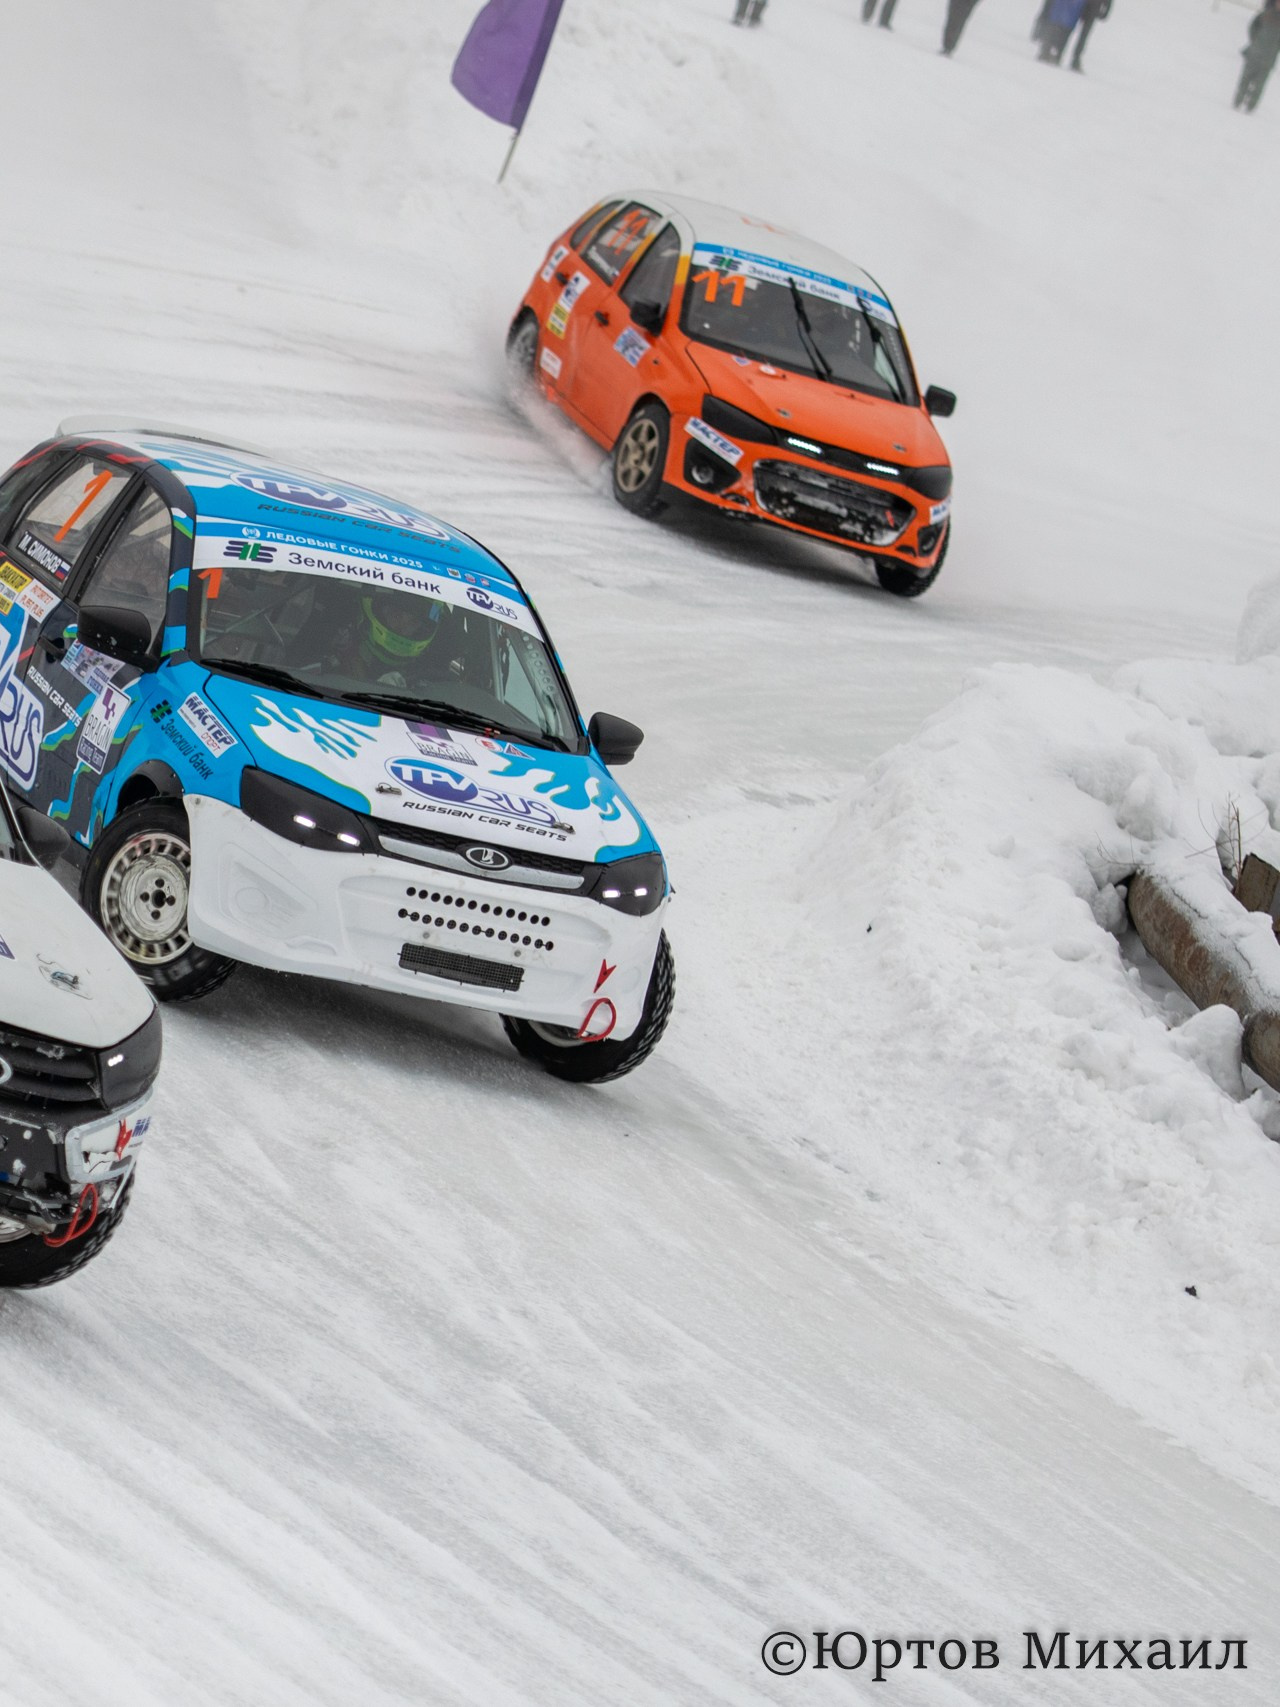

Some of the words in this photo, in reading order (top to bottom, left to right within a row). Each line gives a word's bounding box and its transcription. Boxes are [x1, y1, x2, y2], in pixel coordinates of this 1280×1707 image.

[608, 208, 649, 255] 11
[692, 270, 747, 307] 11
[54, 469, 113, 542] 1
[249, 477, 339, 502] TPV
[266, 530, 338, 550] ЛЕДОВЫЕ
[340, 544, 389, 562] ГОНКИ
[391, 555, 424, 569] 2025
[197, 568, 223, 599] 1
[288, 551, 386, 581] Земский
[391, 571, 442, 595] банк
[468, 590, 493, 606] TPV
[493, 602, 518, 620] RUS
[185, 695, 235, 746] МАСТЕР
[161, 718, 197, 757] Земский
[189, 752, 214, 781] банк
[391, 763, 471, 791] TPV
[472, 787, 556, 826] RUS
